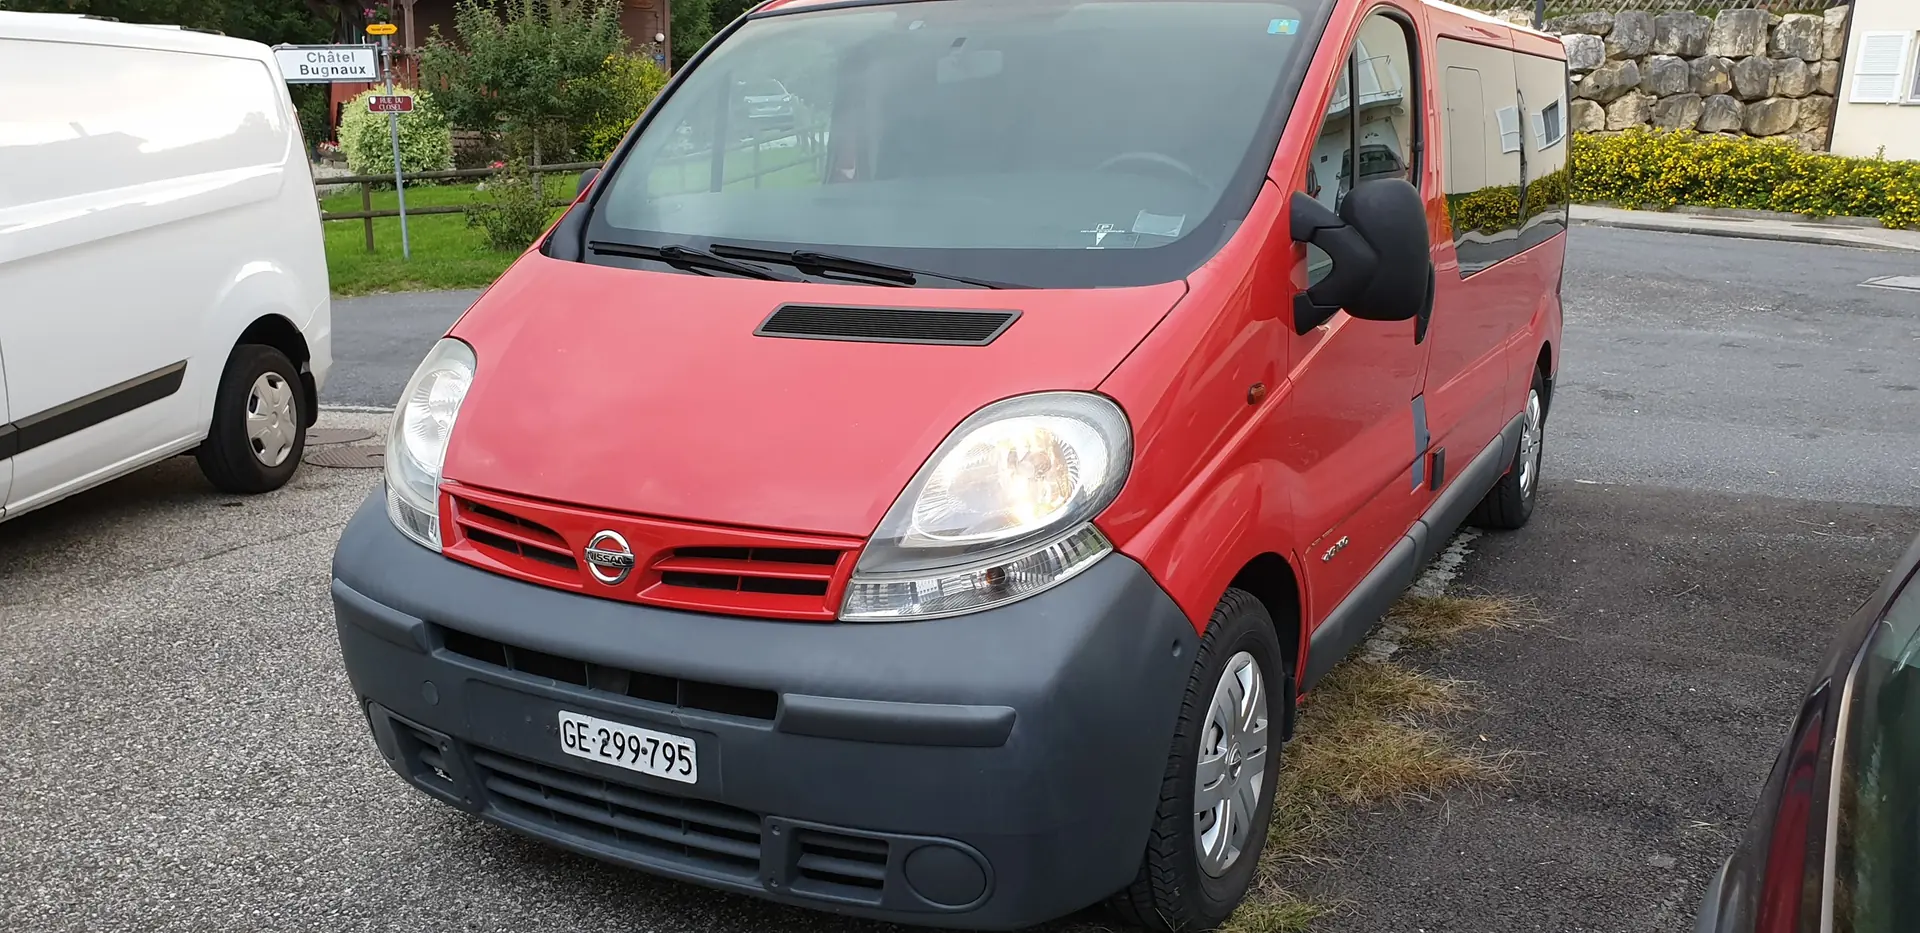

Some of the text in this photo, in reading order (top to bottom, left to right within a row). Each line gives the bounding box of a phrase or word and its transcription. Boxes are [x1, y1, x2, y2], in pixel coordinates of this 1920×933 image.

[306, 51, 355, 63] Châtel
[300, 64, 366, 77] Bugnaux
[587, 551, 628, 566] NISSAN
